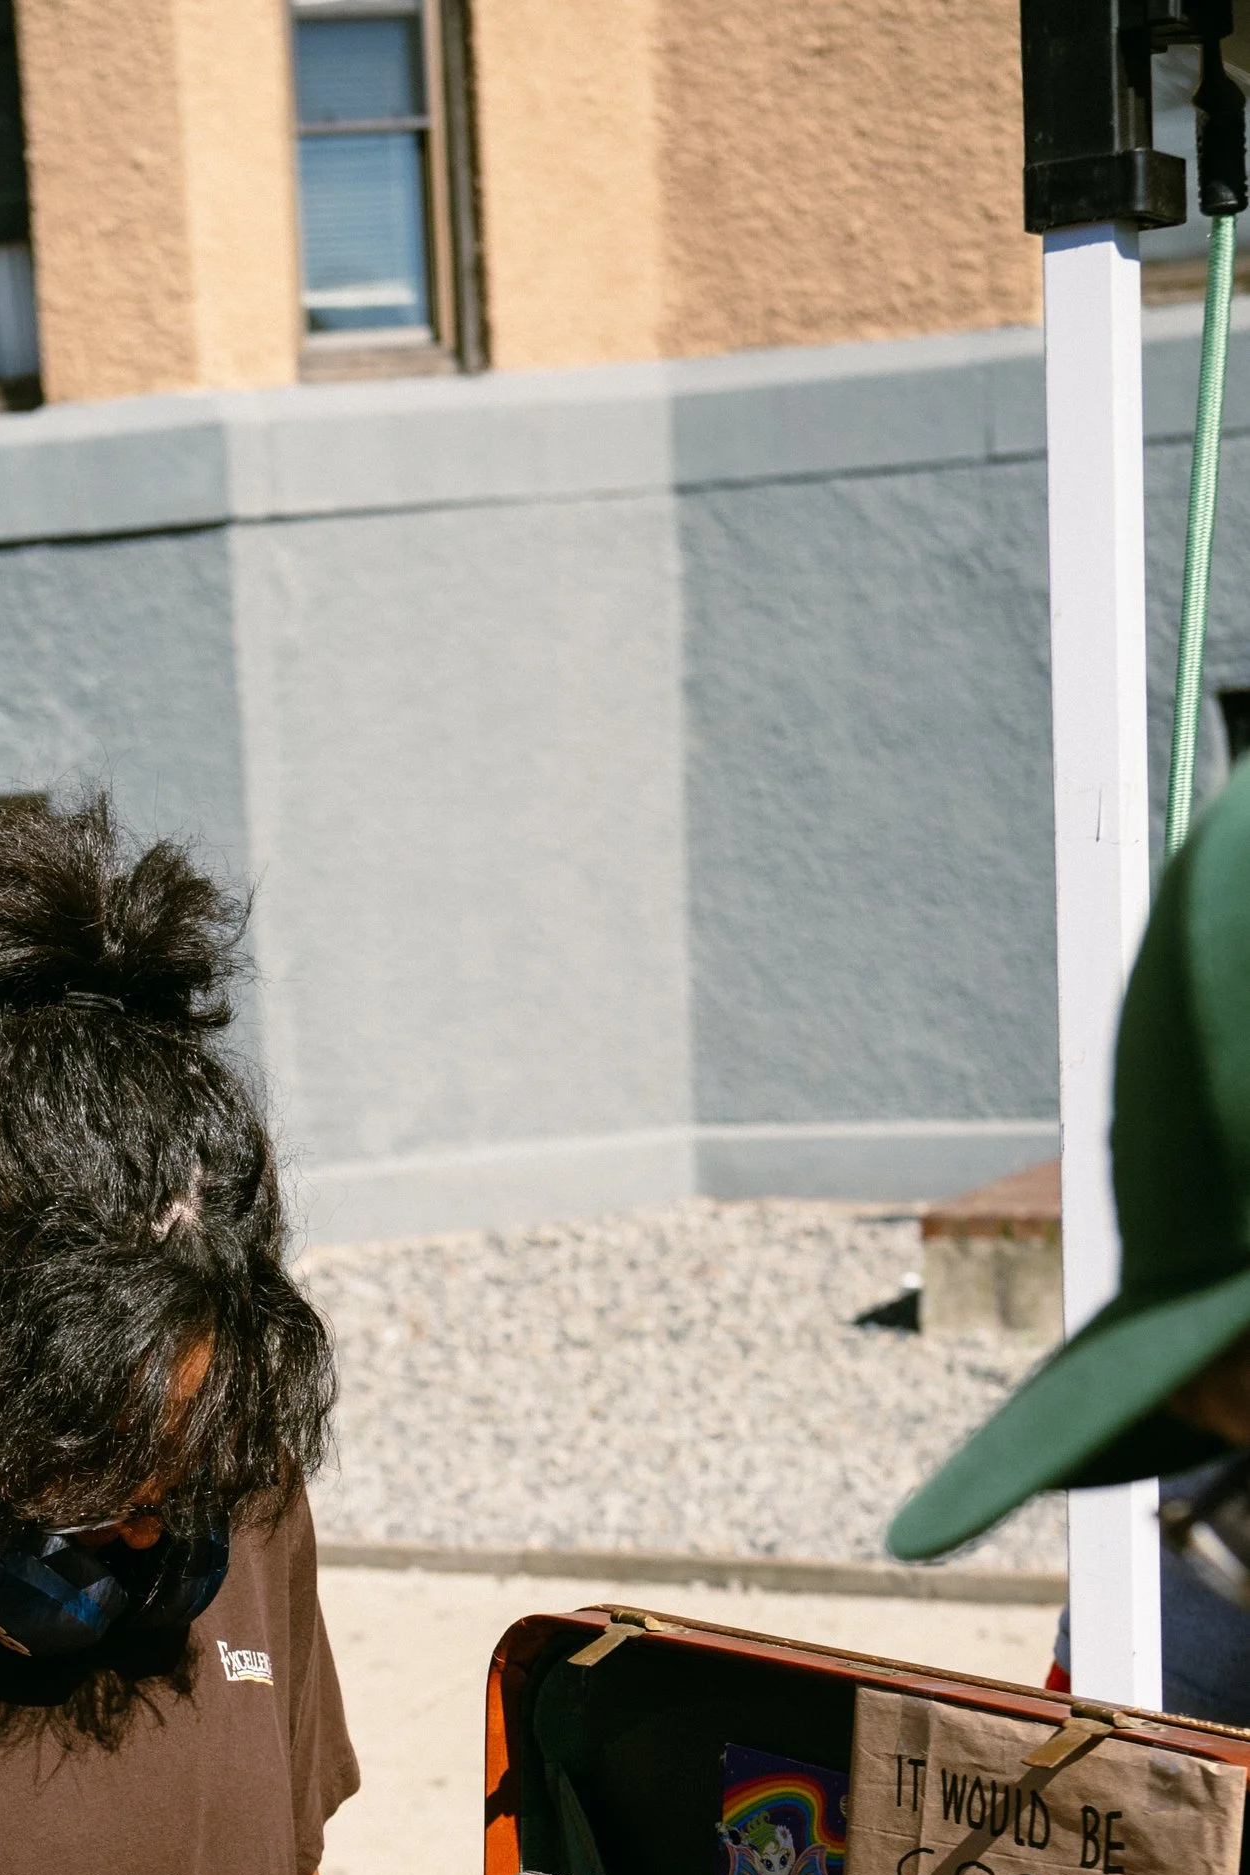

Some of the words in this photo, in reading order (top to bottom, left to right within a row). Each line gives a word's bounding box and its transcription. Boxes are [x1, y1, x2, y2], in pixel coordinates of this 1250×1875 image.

[896, 1753, 926, 1812] IT
[941, 1767, 1050, 1850] WOULD
[1081, 1804, 1126, 1875] BE
